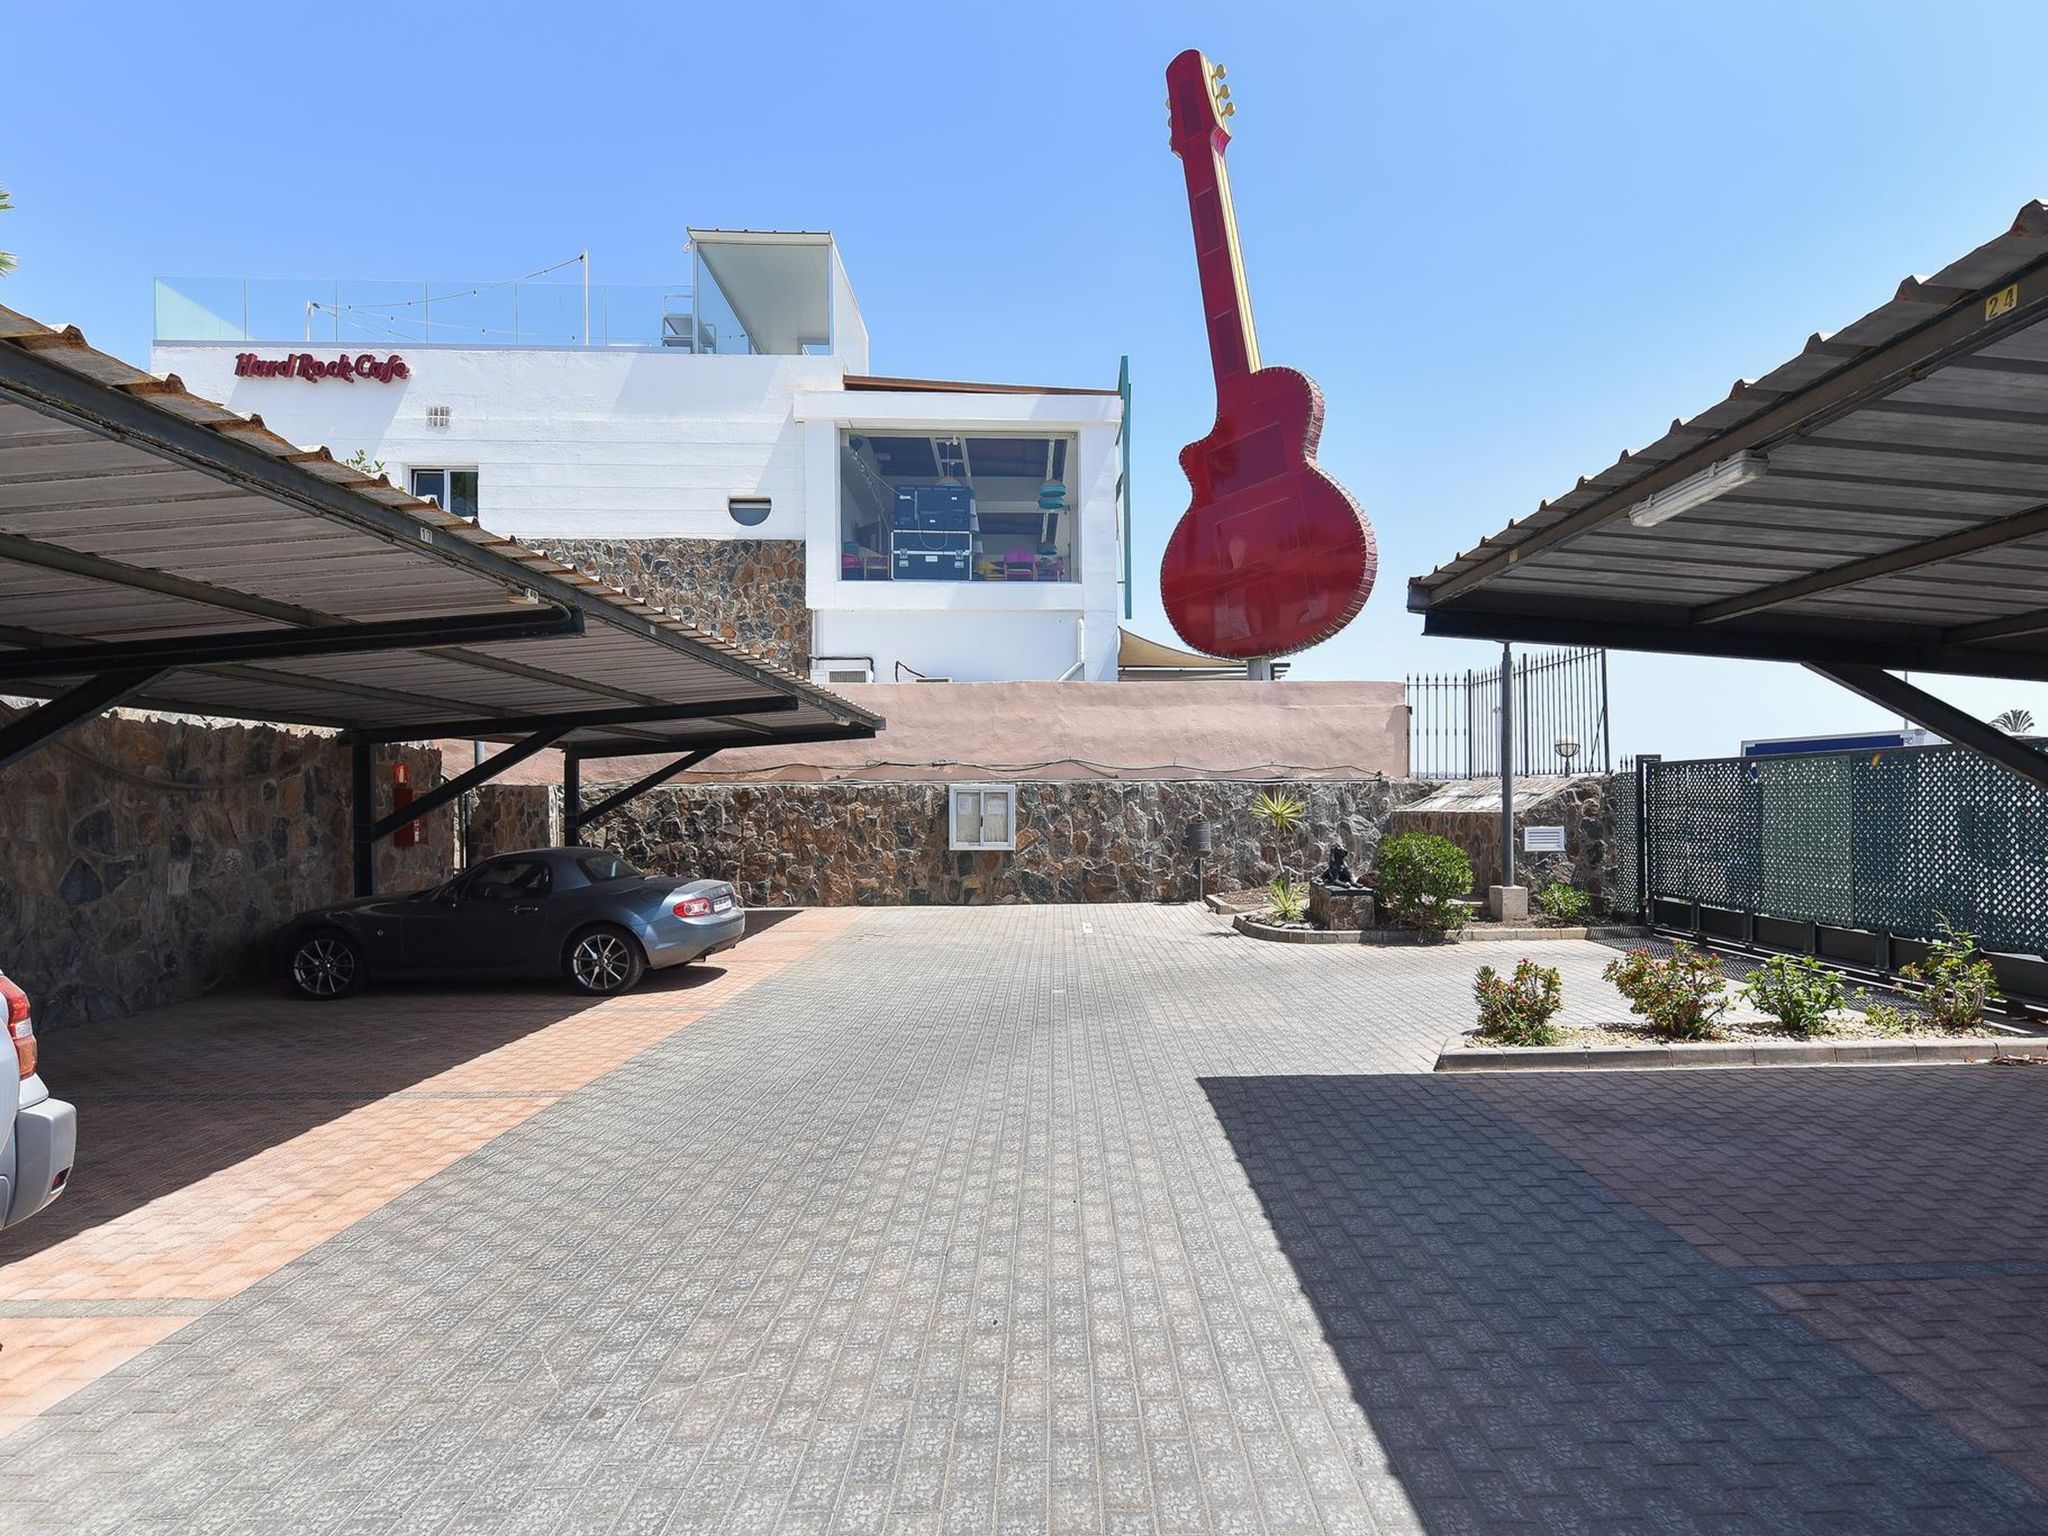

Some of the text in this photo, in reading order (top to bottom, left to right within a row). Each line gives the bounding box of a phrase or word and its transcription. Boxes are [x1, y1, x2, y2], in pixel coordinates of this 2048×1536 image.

[1988, 287, 2015, 318] 24
[235, 353, 410, 383] Hard Rock Cafe
